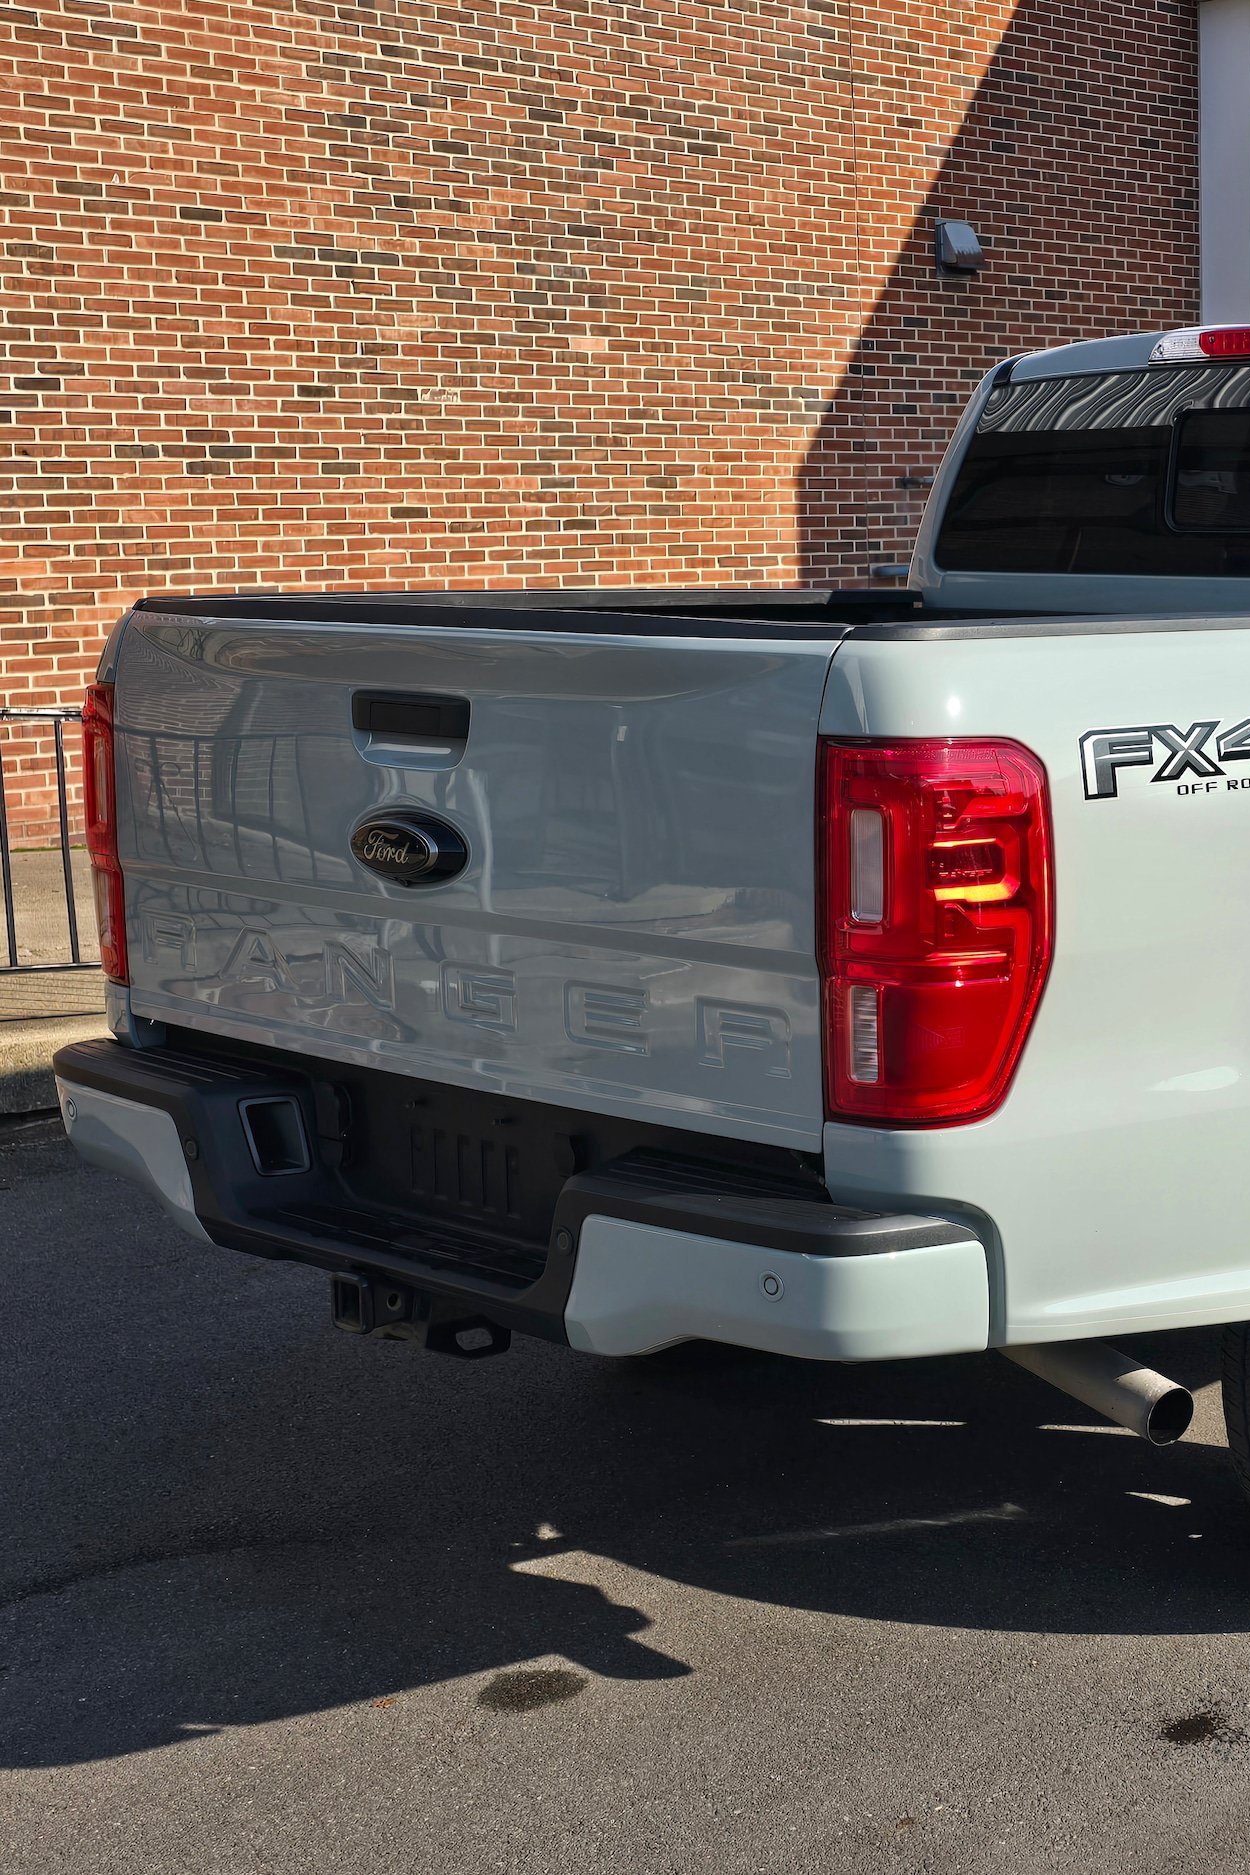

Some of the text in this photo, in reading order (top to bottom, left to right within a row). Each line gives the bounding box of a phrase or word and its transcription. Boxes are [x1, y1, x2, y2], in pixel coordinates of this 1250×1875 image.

[1177, 781, 1218, 796] OFF
[364, 830, 409, 863] Ford
[142, 906, 793, 1080] RANGER
